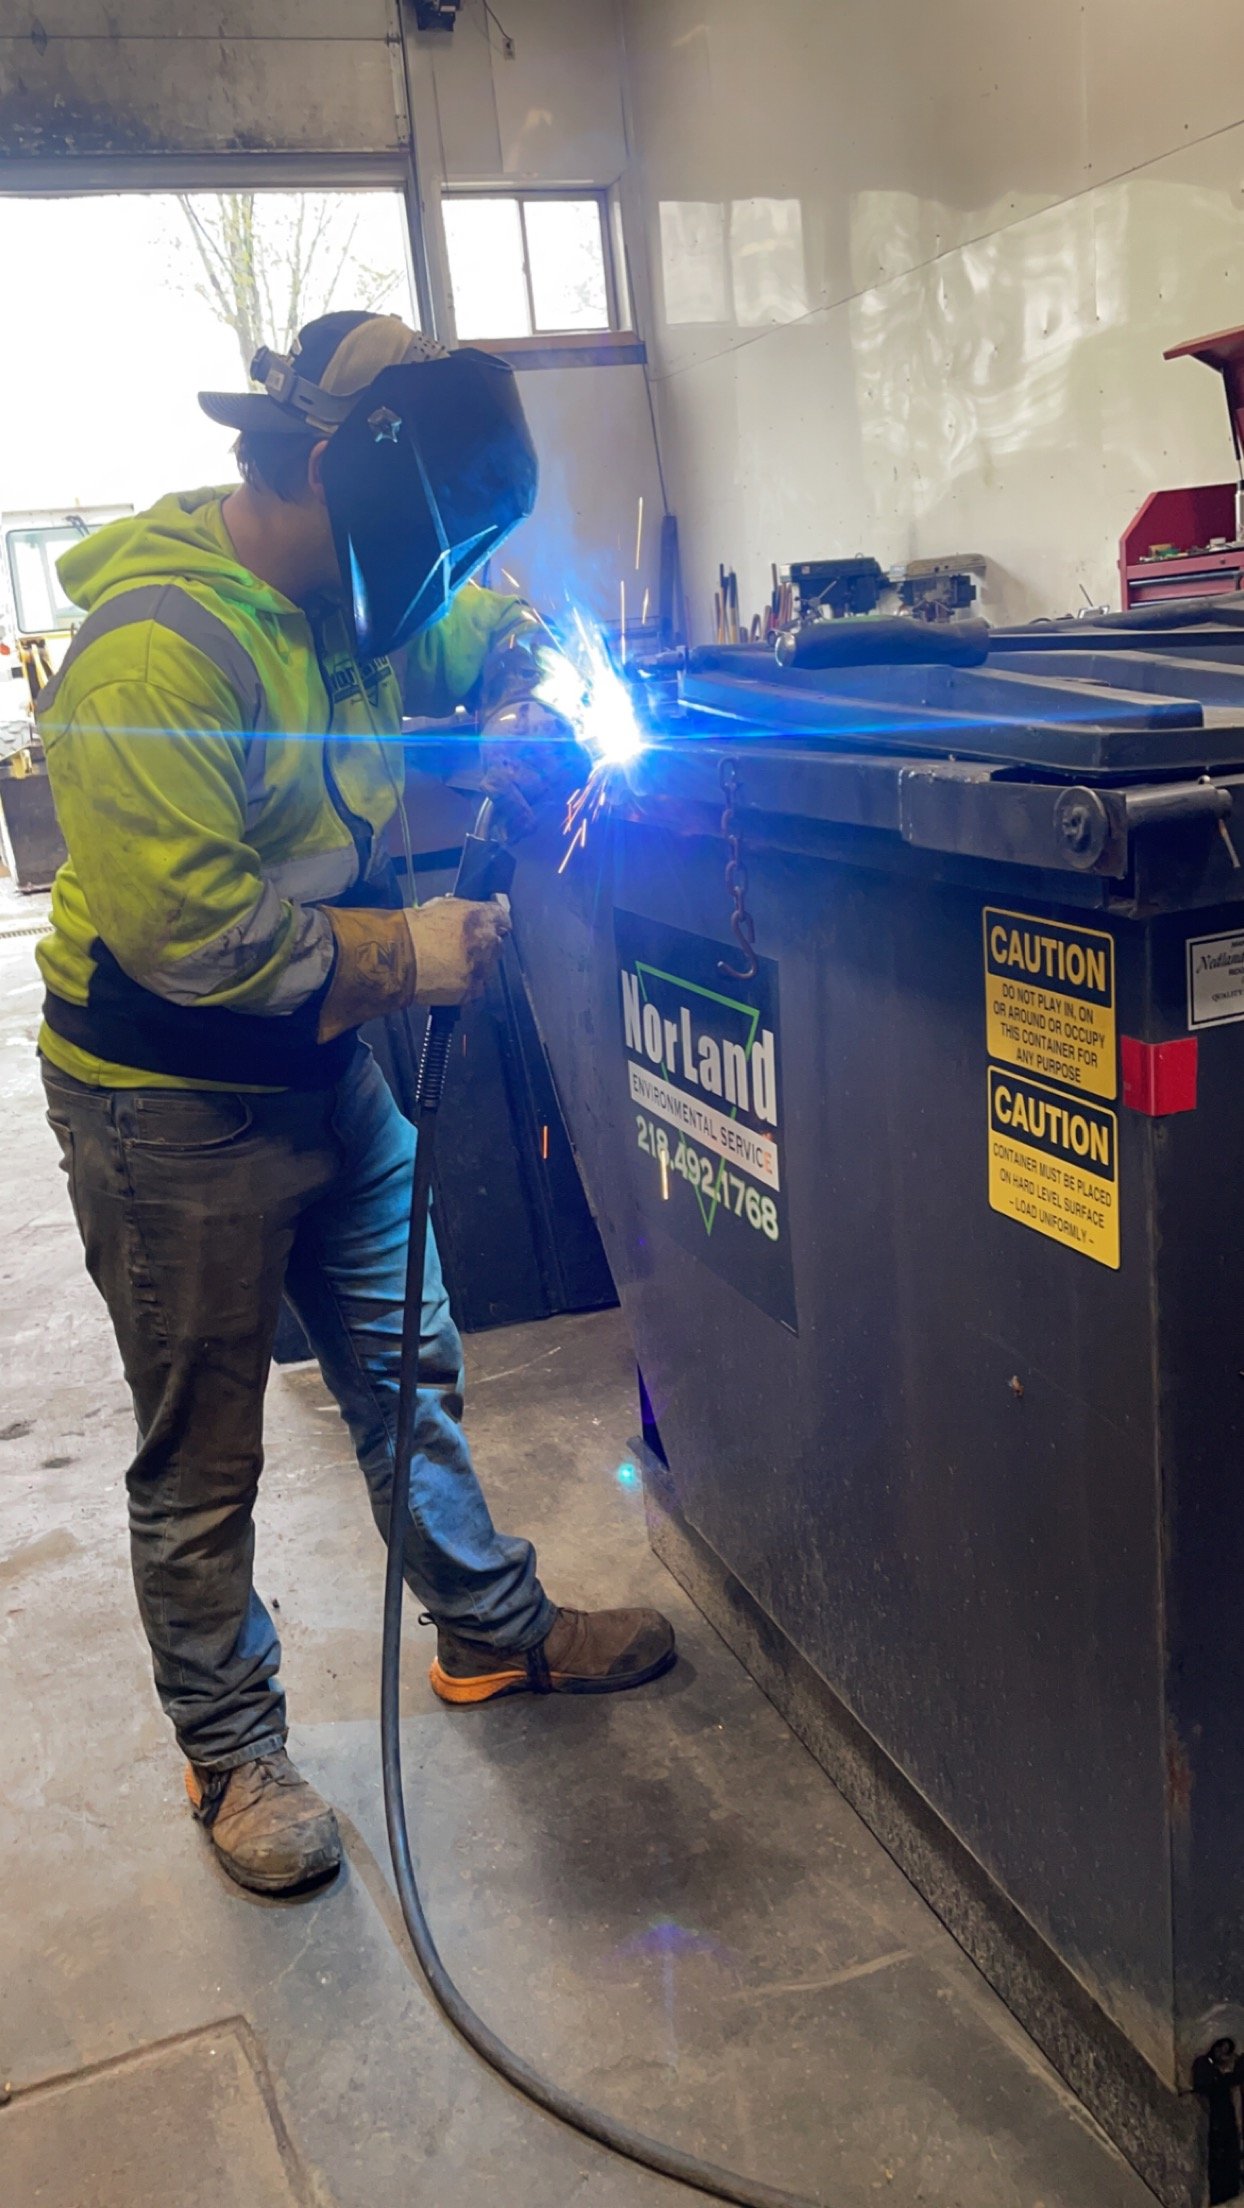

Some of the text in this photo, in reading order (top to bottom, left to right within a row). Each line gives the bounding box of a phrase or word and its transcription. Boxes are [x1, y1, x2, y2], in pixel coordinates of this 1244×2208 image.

[990, 925, 1106, 992] CAUTION
[993, 1000, 1105, 1049] OR AROUND OR OCCUPY
[1002, 983, 1014, 999] DO
[1017, 987, 1035, 1005] NOT
[1038, 993, 1062, 1014] PLAY
[1078, 1006, 1094, 1024] ON
[621, 969, 778, 1127] NorLand
[1000, 1022, 1098, 1068] THIS CONTAINER FOR
[1016, 1047, 1081, 1084] ANY PURPOSE
[632, 1074, 773, 1175] ENVIRONMENTAL SERVICE
[994, 1085, 1109, 1166] CAUTION
[993, 1142, 1112, 1207] CONTAINER MUST BE PLACED
[1000, 1168, 1105, 1229] ON HARD LEVEL SURFACE
[1015, 1197, 1037, 1219] LOAD
[1039, 1209, 1088, 1244] UNIFORMLY
